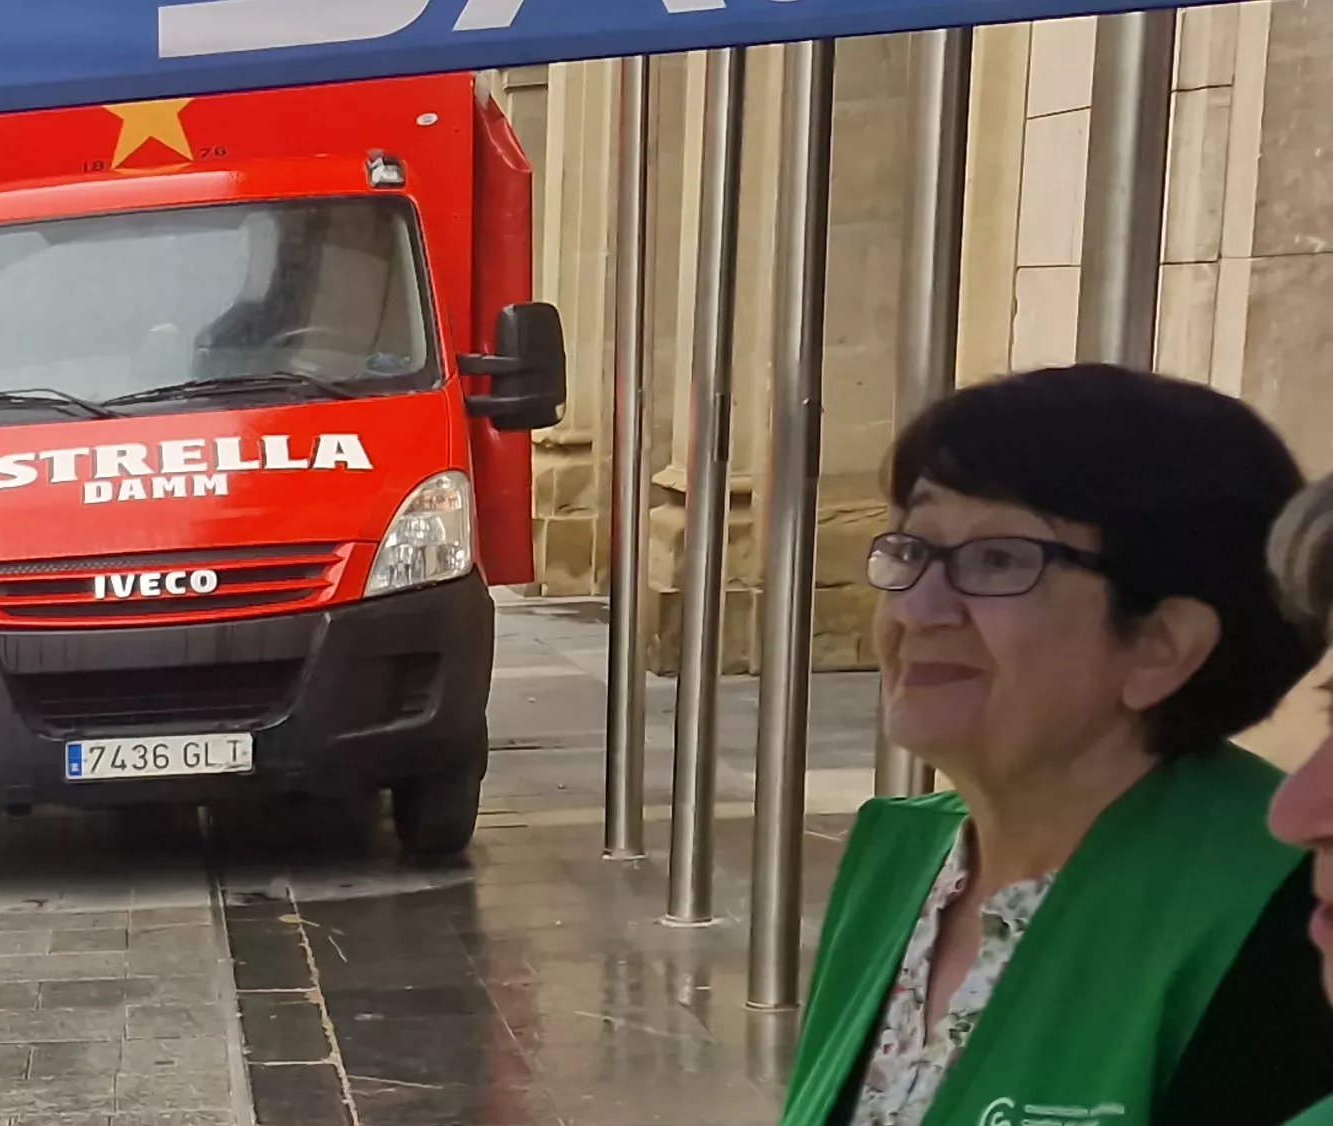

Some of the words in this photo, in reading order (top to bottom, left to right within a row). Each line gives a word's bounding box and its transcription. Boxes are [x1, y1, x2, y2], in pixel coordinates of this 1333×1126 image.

[83, 160, 104, 173] 18
[200, 146, 227, 159] 76
[83, 474, 229, 504] DAMM
[94, 569, 218, 600] IVECO
[88, 743, 170, 773] 7436
